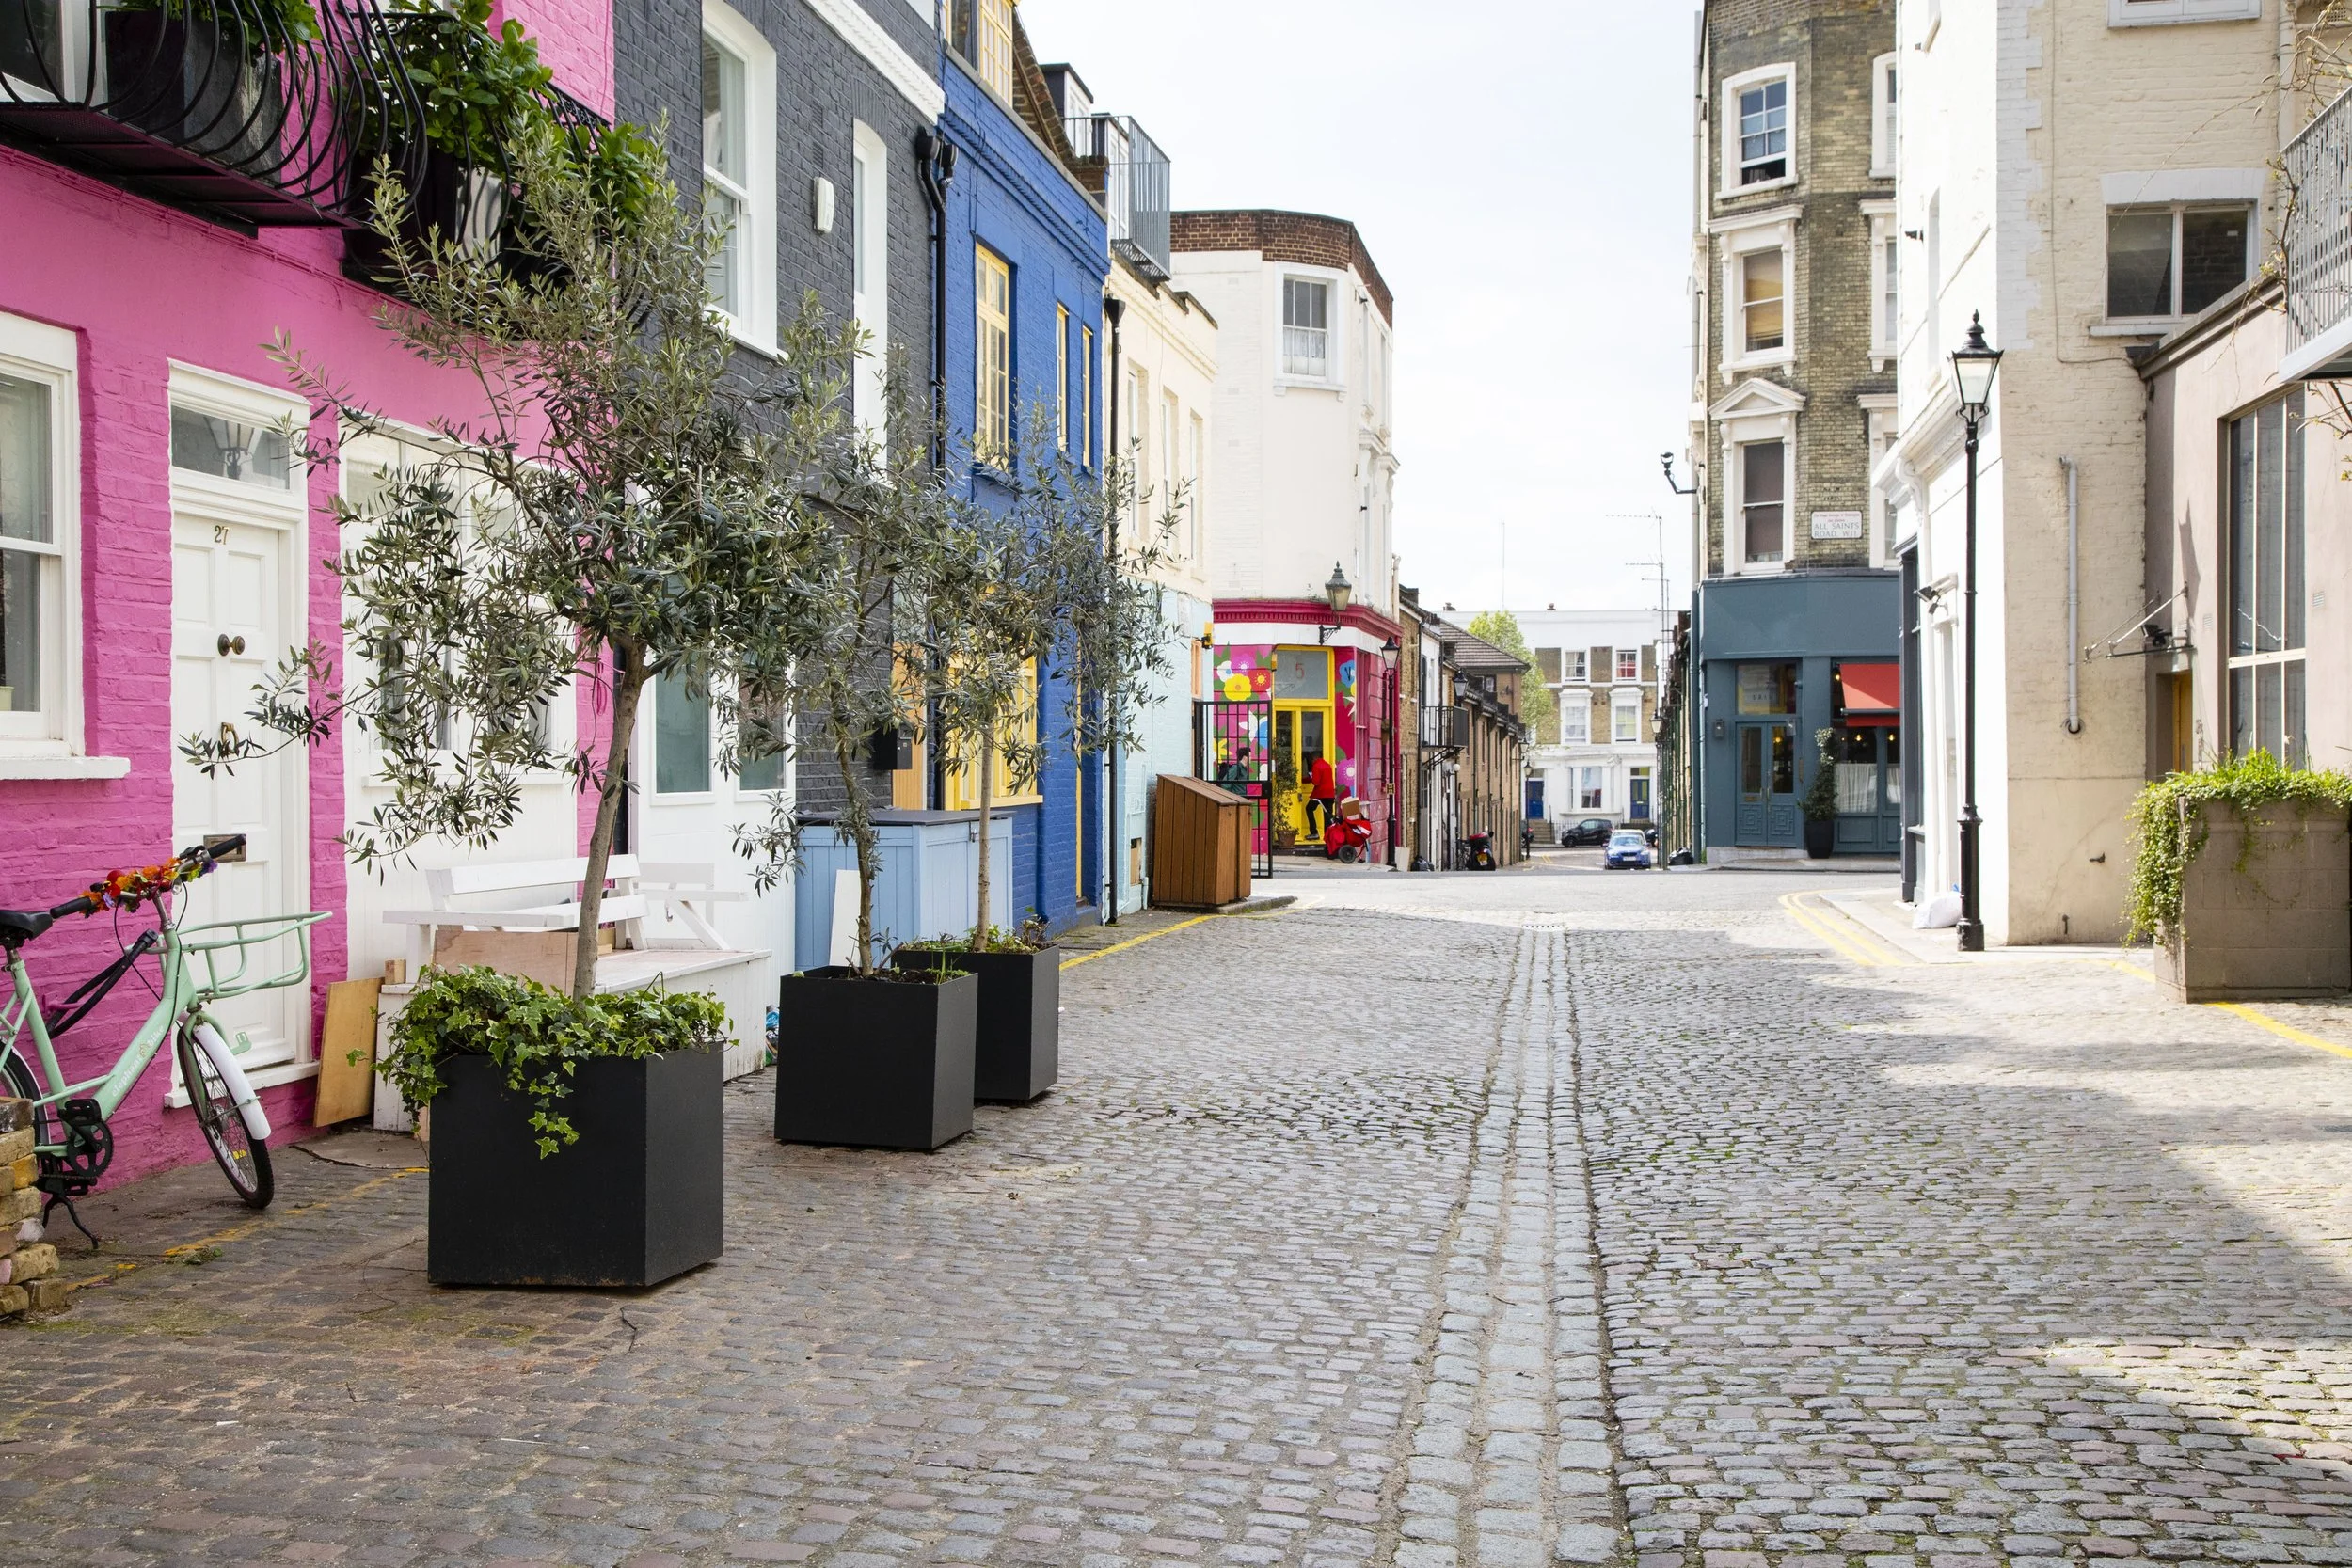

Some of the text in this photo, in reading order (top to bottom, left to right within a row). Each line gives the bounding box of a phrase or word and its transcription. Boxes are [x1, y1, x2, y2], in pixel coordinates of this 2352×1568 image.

[1814, 521, 1860, 531] ALL SAINTS
[215, 525, 230, 545] 27
[1814, 530, 1837, 538] ROAD
[1295, 663, 1305, 679] 5
